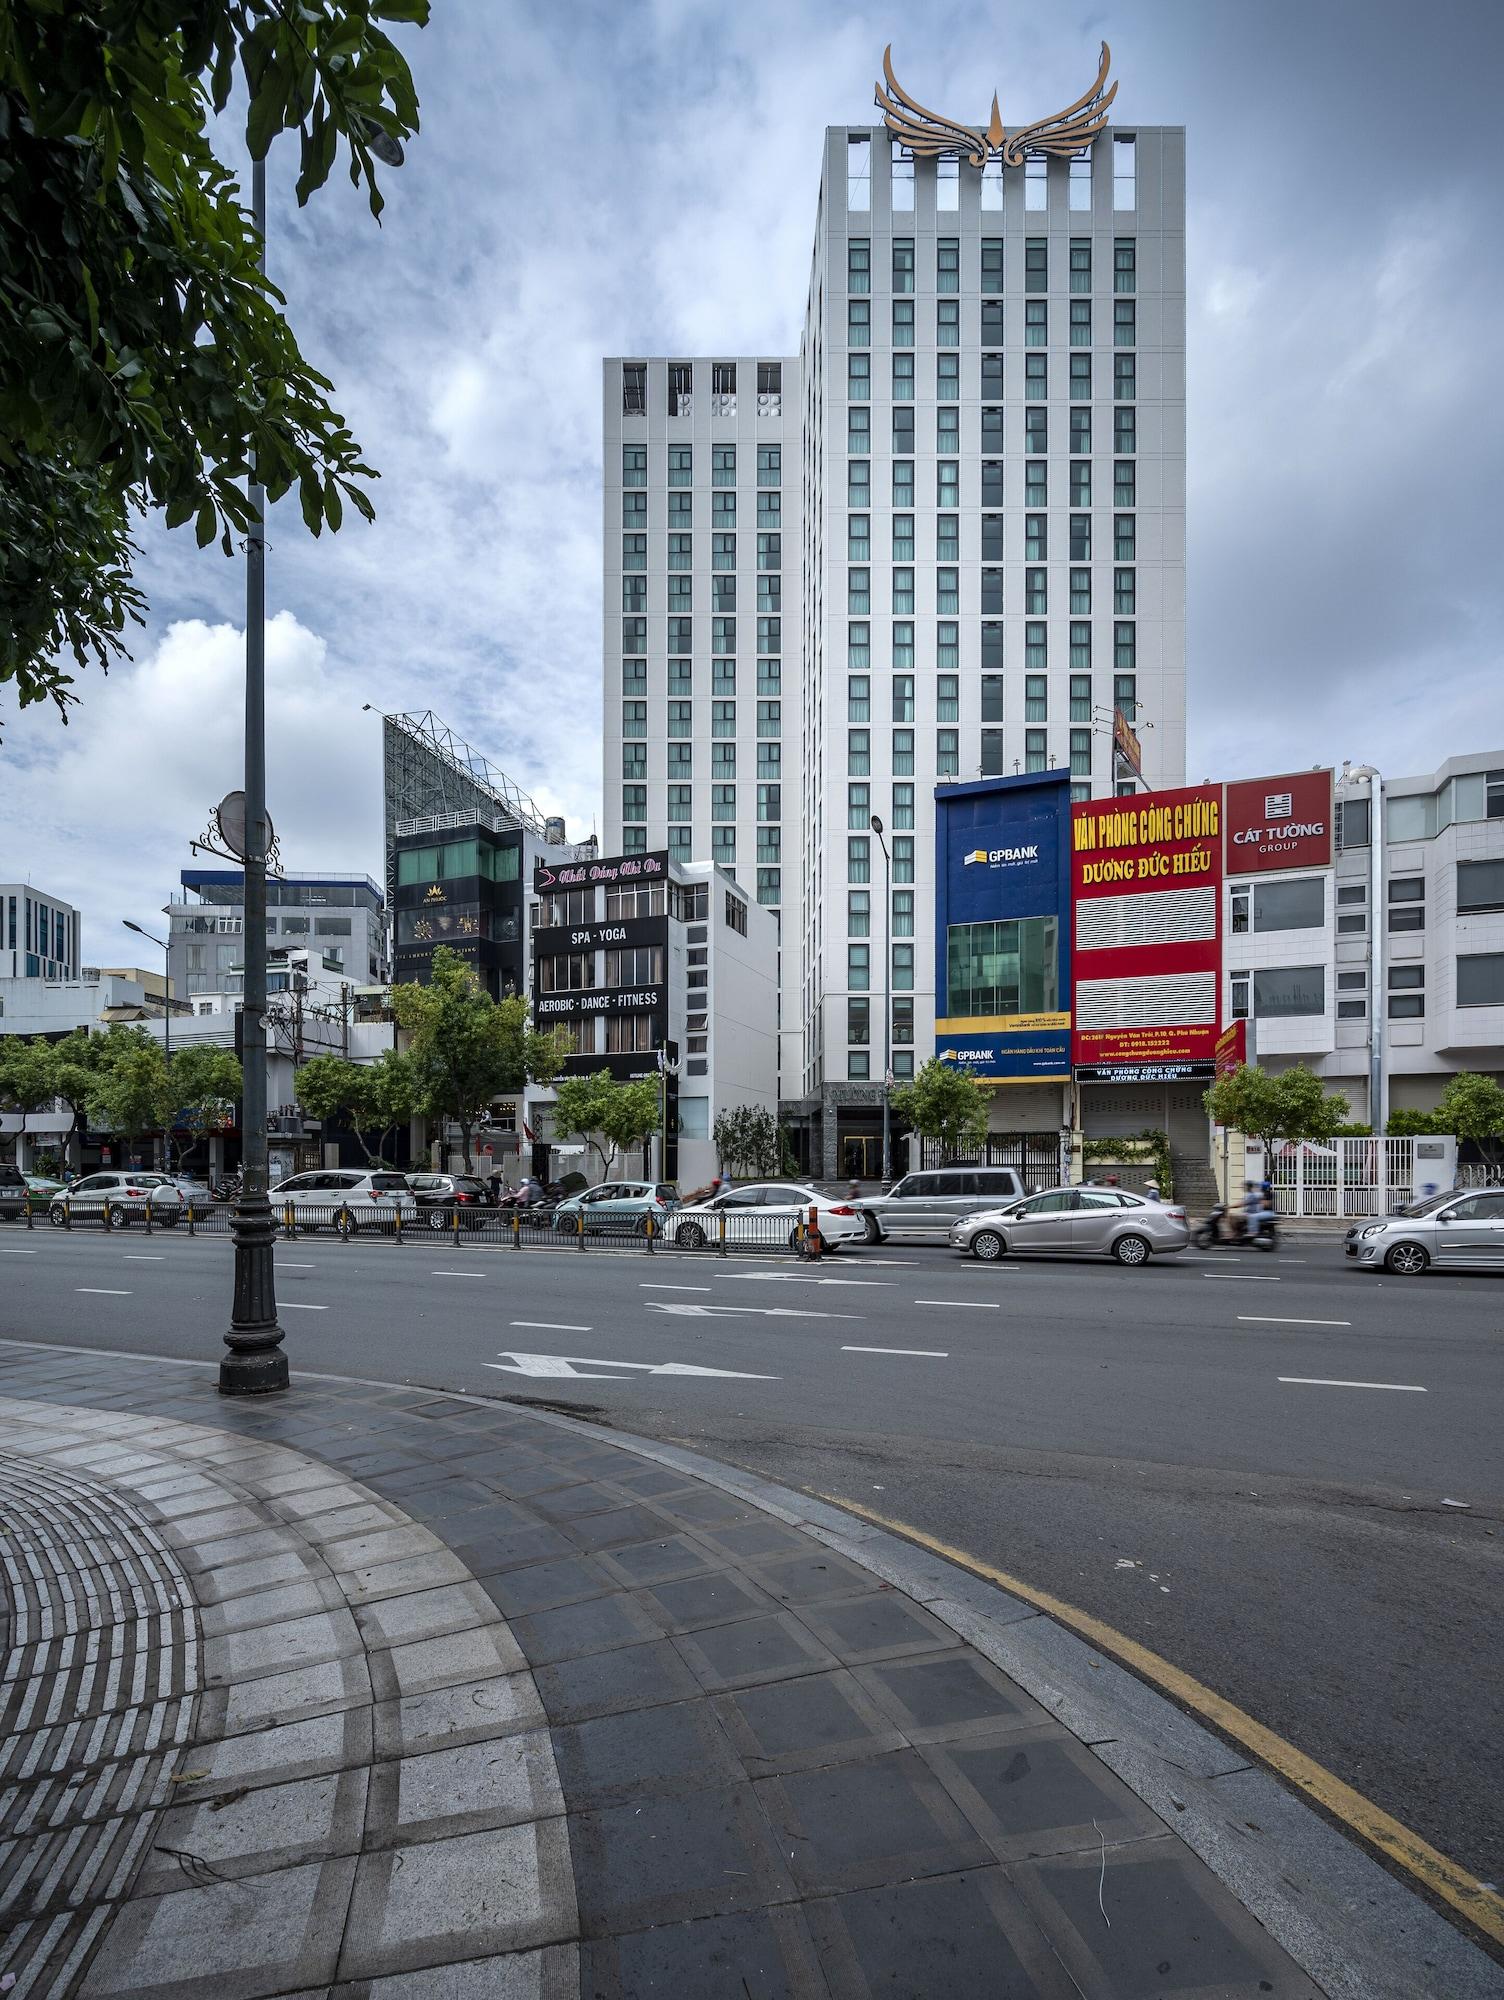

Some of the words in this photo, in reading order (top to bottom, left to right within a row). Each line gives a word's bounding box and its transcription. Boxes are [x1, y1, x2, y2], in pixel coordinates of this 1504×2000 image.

[1073, 811, 1096, 851] VĂN
[1098, 808, 1137, 849] PHÒNG
[1140, 802, 1172, 845] CÔNG
[1174, 796, 1218, 840] CHỨNG
[1233, 827, 1262, 844] CÁT
[1266, 822, 1324, 840] TƯỜNG
[989, 845, 1039, 863] GPBANK
[1259, 841, 1298, 853] GROUP
[558, 867, 586, 884] Nhất
[589, 865, 618, 880] Dáng
[619, 860, 641, 876] Nhì
[1082, 858, 1135, 884] DƯƠNG
[1138, 850, 1169, 878] ĐỨC
[1172, 843, 1211, 874] HIẾU
[571, 932, 591, 944] SPA
[599, 928, 627, 941] YOGA
[538, 999, 575, 1012] AEROBIC
[581, 996, 610, 1010] DANCE
[618, 992, 658, 1007] FITNESS
[957, 1050, 994, 1060] GPBANK
